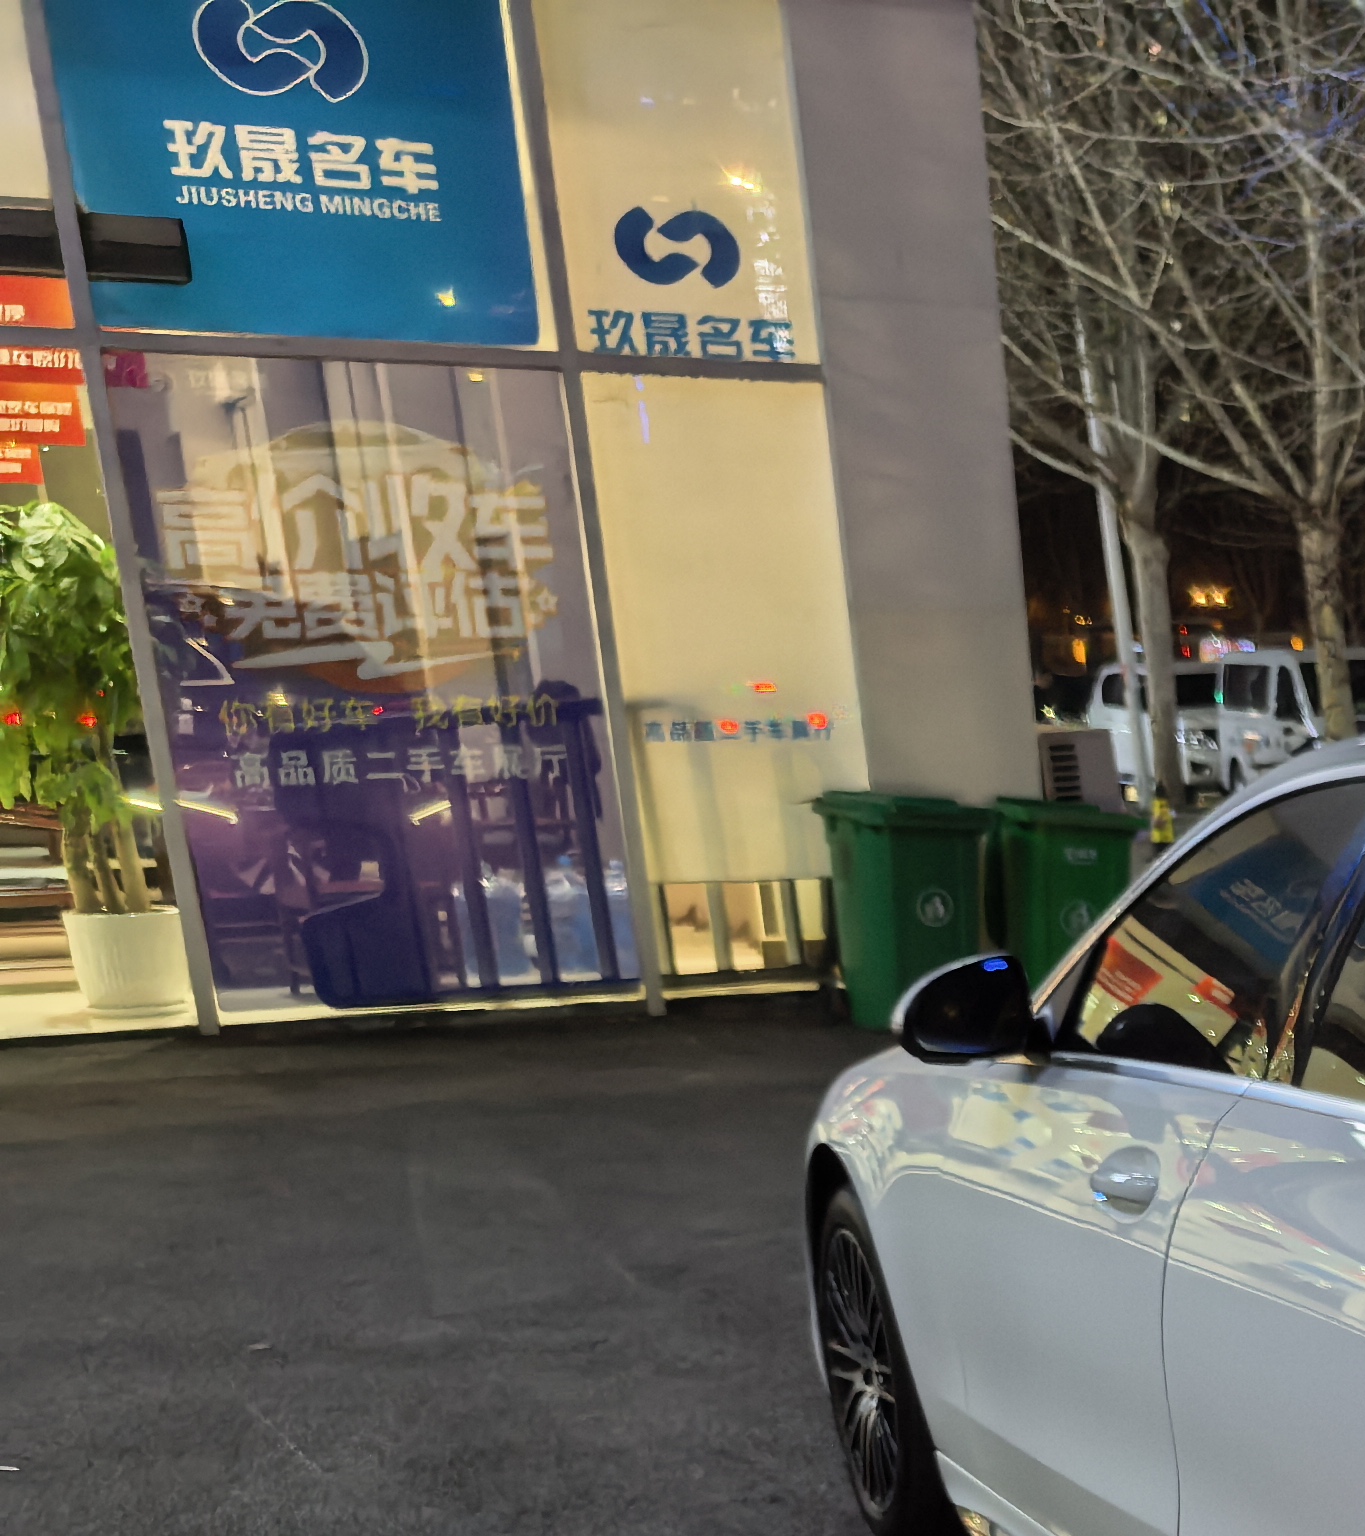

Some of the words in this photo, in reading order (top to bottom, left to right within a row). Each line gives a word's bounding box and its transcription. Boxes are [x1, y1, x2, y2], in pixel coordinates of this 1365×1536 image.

[162, 118, 440, 195] 玖晟名车
[175, 185, 314, 213] JIUSHENG
[319, 193, 443, 222] MINGCHE
[587, 309, 796, 361] 玖晟名车
[156, 473, 554, 580] 高价收车
